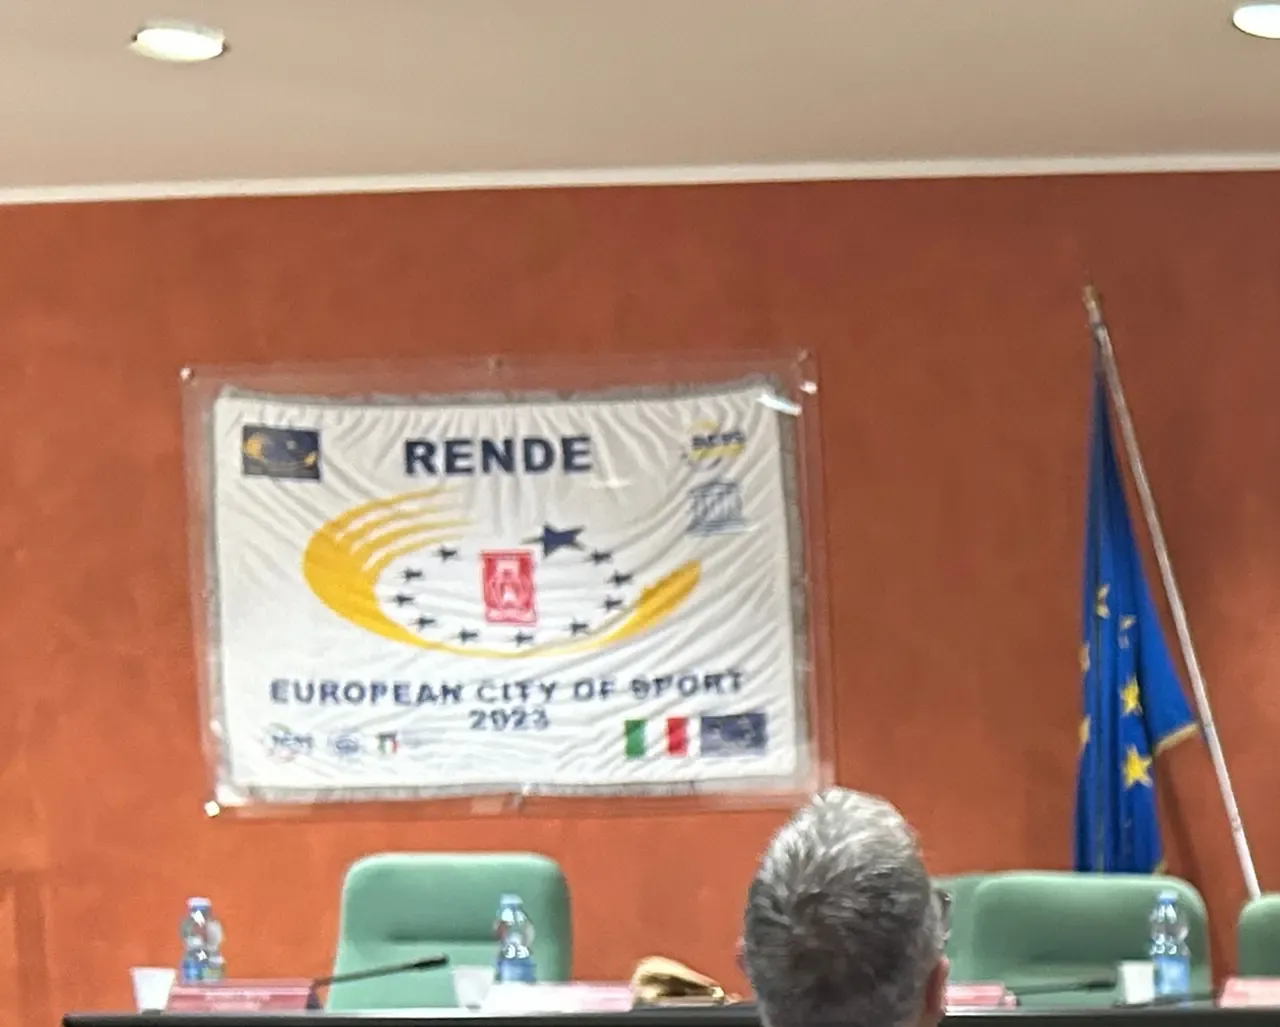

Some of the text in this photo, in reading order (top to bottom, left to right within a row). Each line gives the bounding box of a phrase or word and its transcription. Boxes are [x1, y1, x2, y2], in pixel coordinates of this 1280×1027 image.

[405, 436, 593, 475] RENDE
[269, 672, 743, 706] EUROPEAN CITY OF SPORT
[469, 709, 550, 731] 2023
